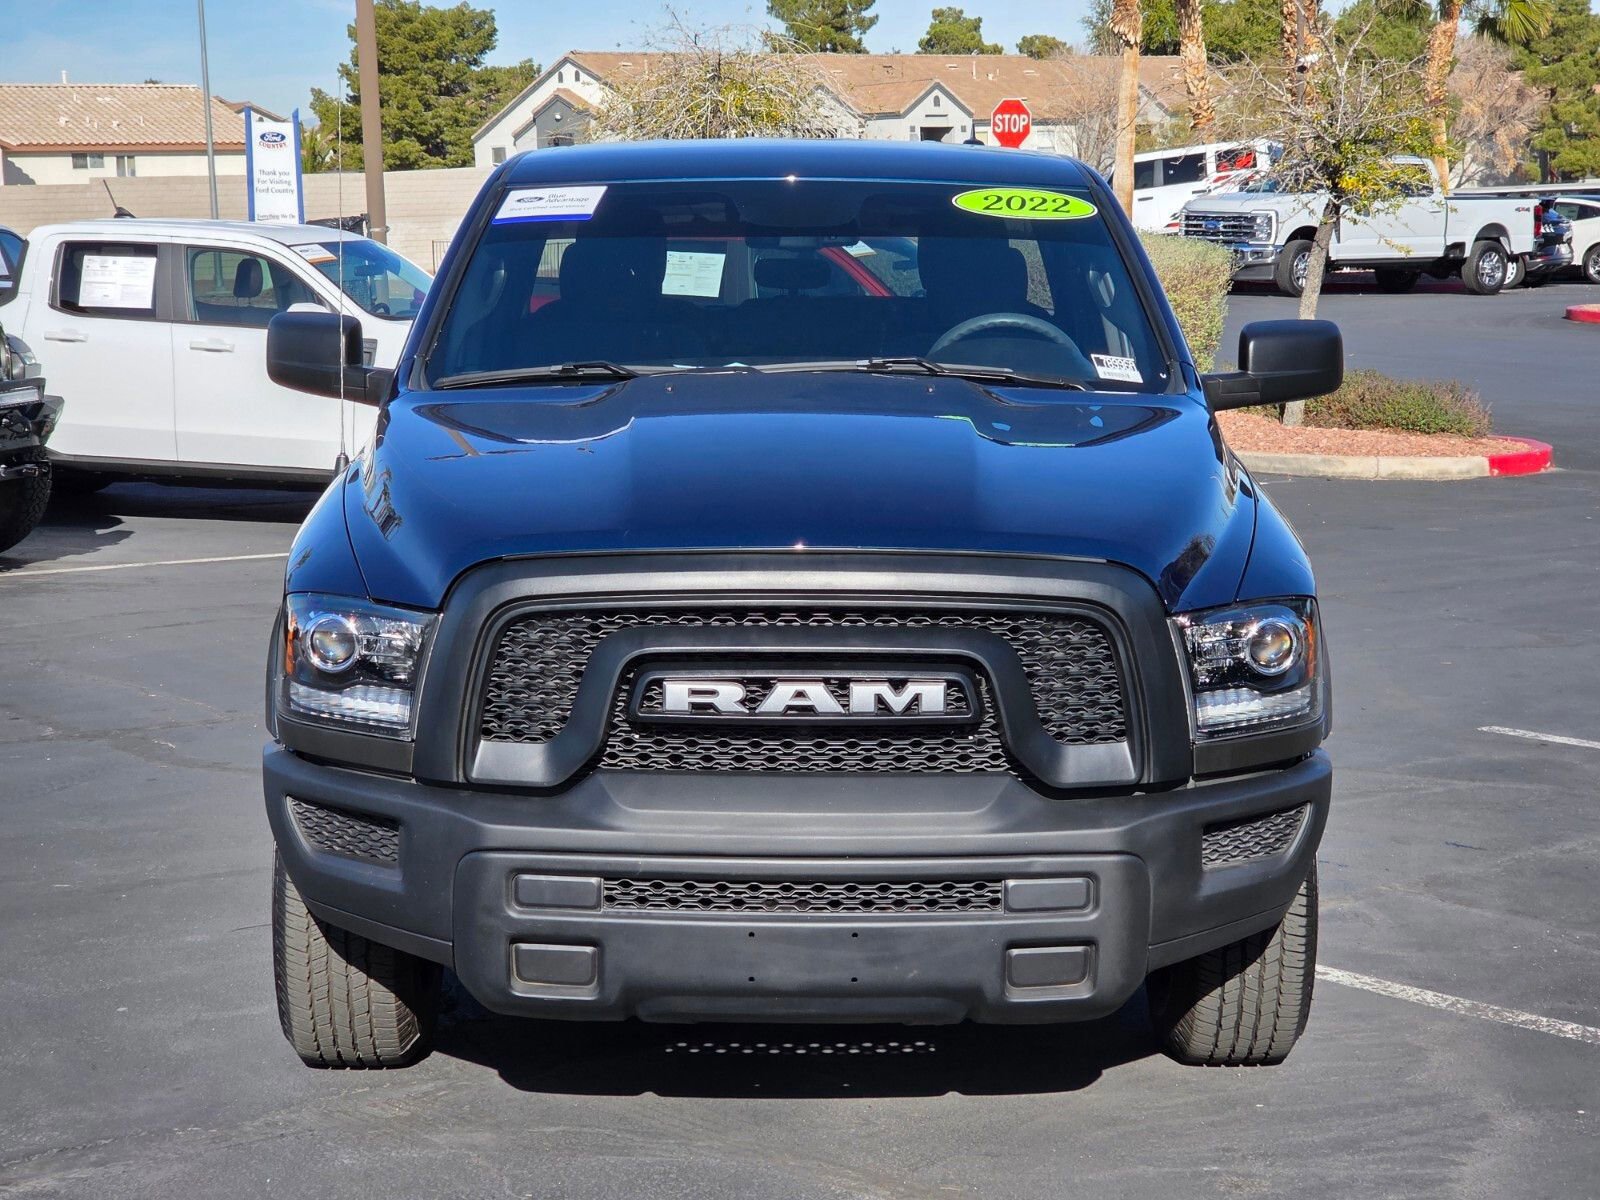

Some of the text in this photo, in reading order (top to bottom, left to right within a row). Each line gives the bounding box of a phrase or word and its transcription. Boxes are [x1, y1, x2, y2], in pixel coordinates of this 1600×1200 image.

[994, 113, 1029, 133] STOP
[270, 178, 292, 186] Visiting
[278, 170, 290, 178] you
[982, 194, 1071, 214] 2022
[662, 680, 948, 714] RAM
